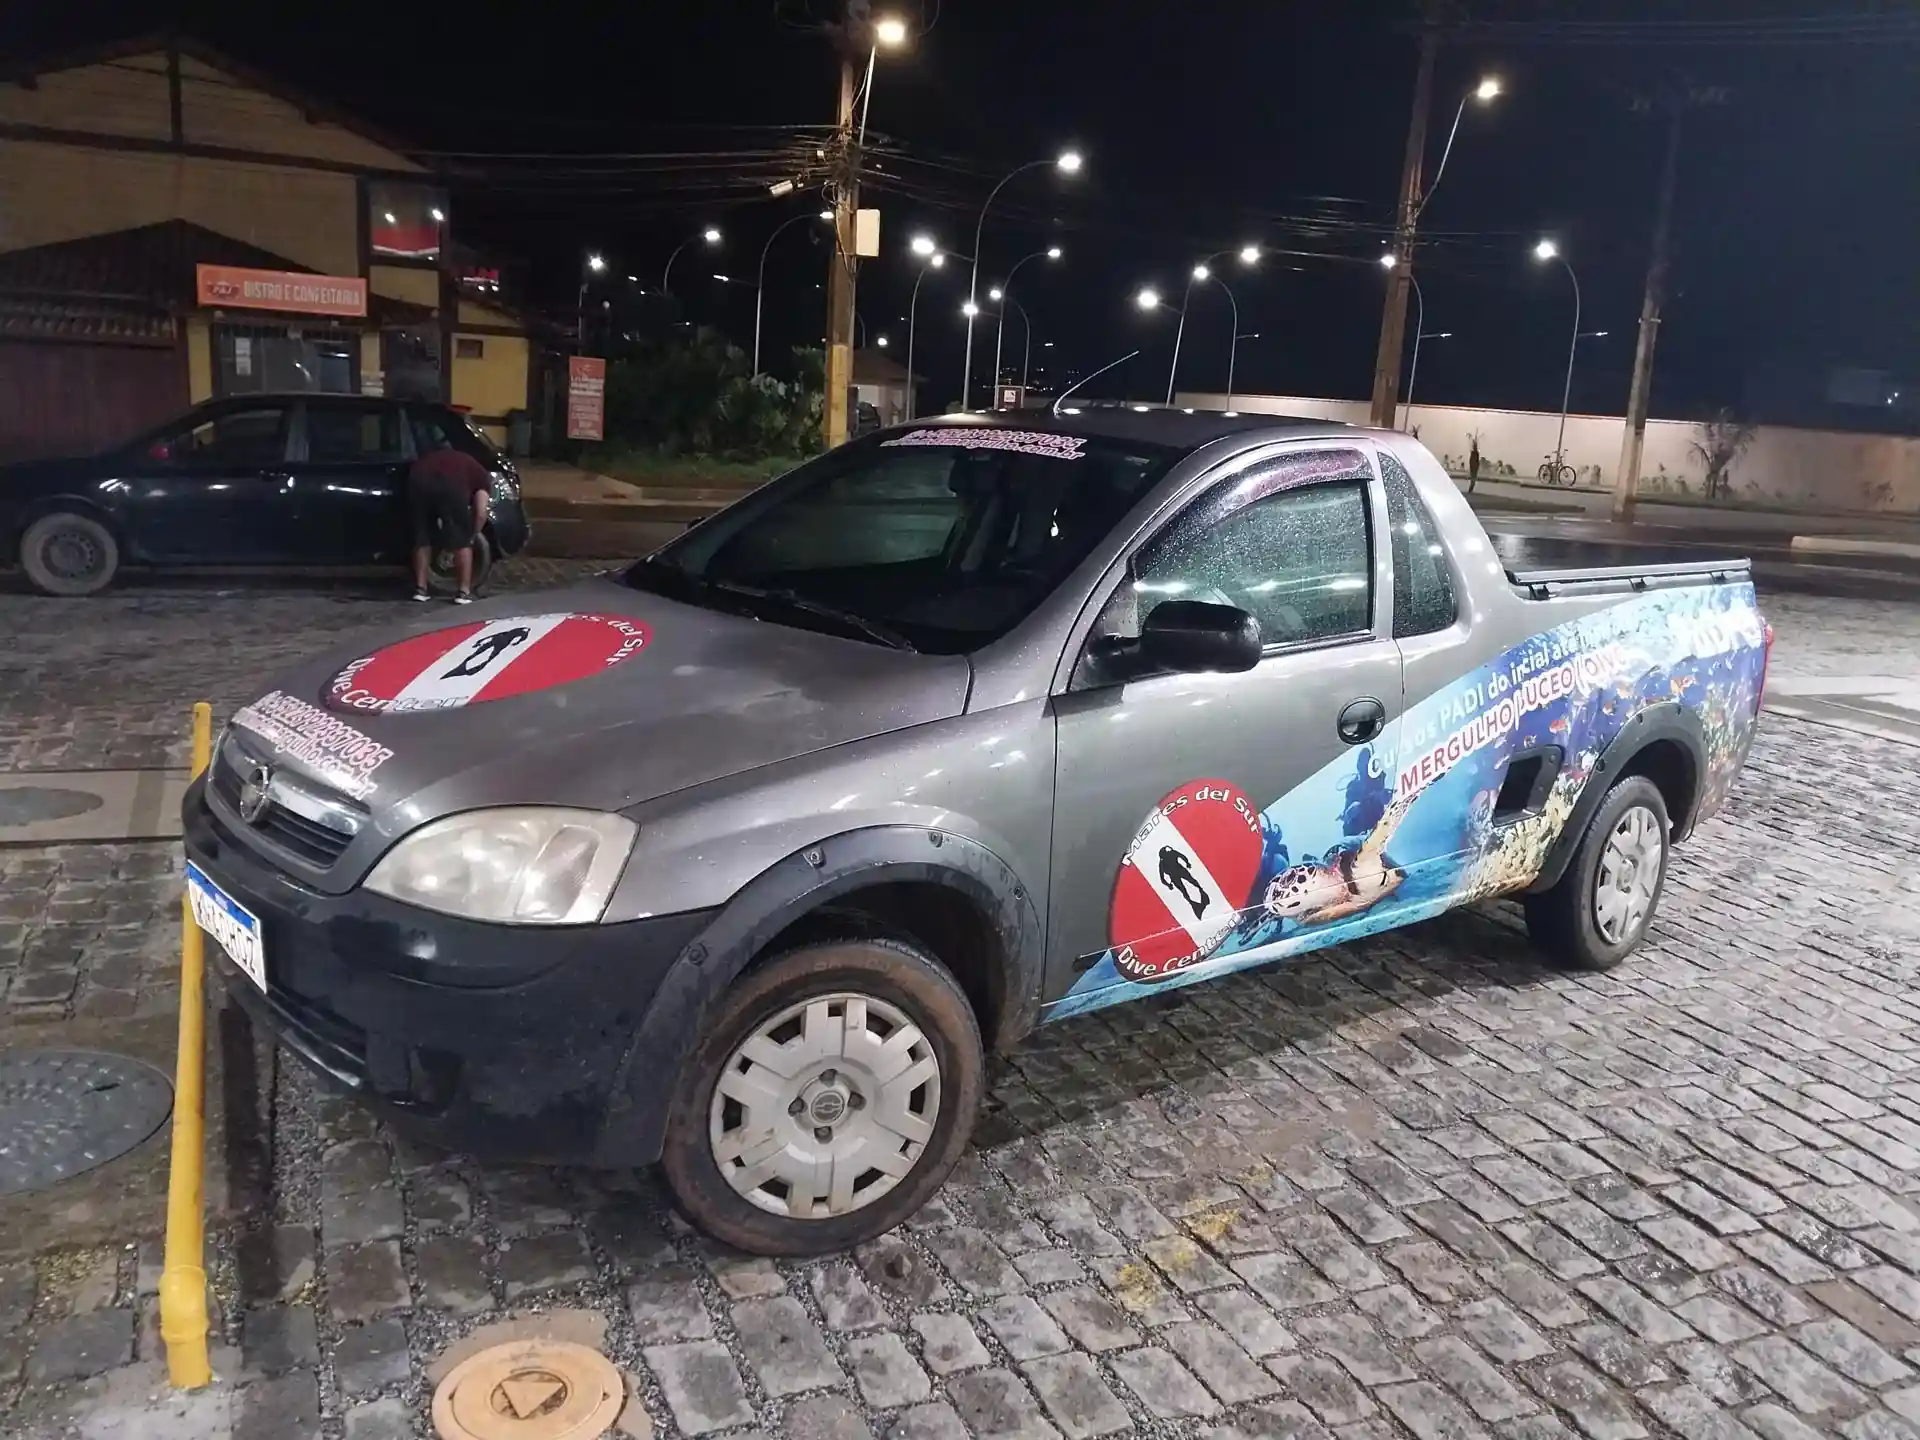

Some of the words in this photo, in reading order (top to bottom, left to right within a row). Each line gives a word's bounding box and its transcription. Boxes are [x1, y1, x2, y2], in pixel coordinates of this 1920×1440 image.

[284, 284, 292, 301] E
[294, 285, 360, 306] CONFEITARIA
[332, 657, 376, 694] Dive
[341, 689, 470, 711] Center
[1441, 682, 1485, 732] PADI
[1121, 794, 1188, 867] Mares
[1195, 785, 1230, 802] del
[1233, 796, 1260, 834] Sur
[1117, 945, 1157, 976] Dive
[1162, 912, 1243, 973] Center
